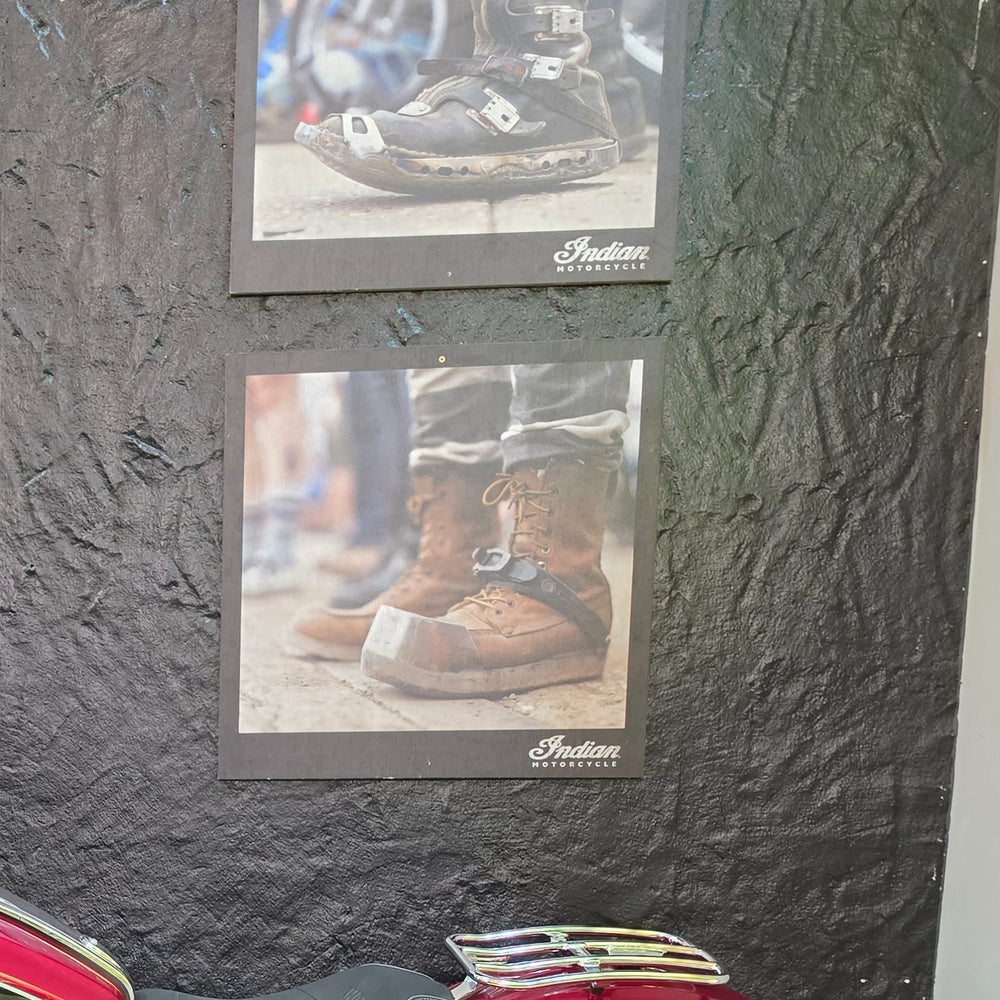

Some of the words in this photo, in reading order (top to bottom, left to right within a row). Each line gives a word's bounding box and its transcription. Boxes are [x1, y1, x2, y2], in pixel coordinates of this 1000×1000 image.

[553, 236, 650, 264] Indian
[556, 263, 646, 272] MOTORCYCLE
[528, 735, 621, 760] Indian
